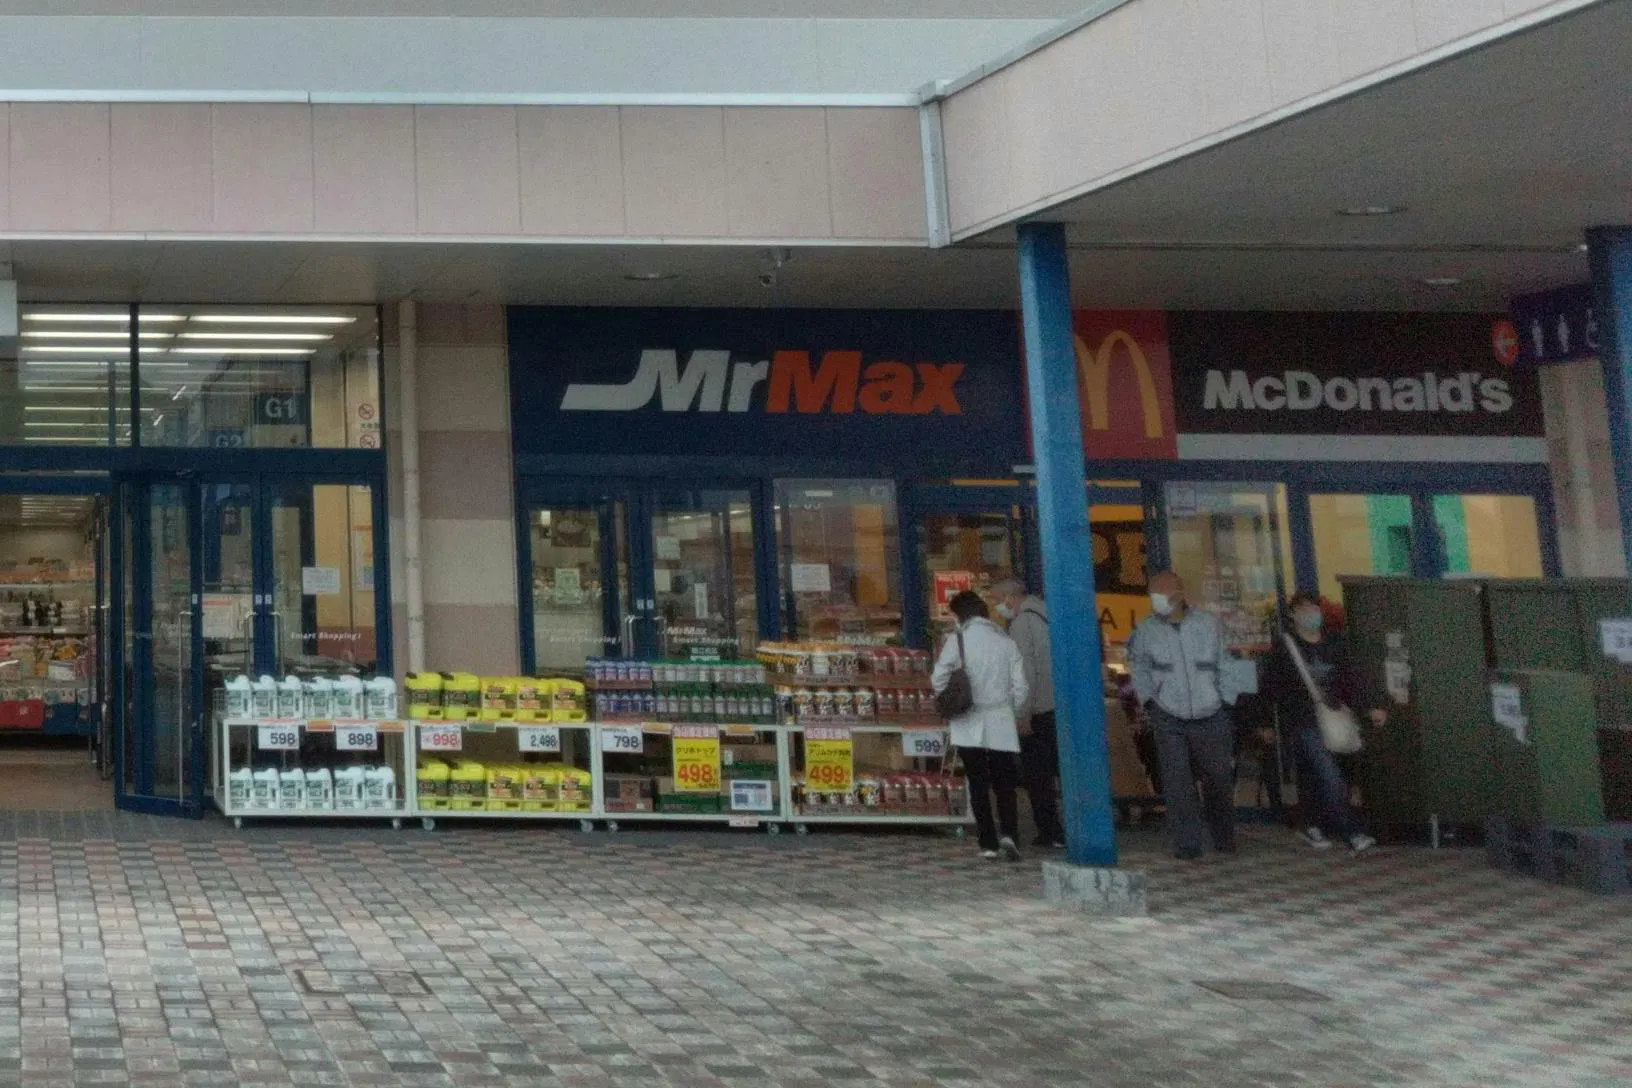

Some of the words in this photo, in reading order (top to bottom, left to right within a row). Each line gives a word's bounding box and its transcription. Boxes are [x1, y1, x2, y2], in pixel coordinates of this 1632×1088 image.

[558, 347, 966, 416] MrMax
[1202, 369, 1514, 413] McDonald's
[269, 731, 296, 746] 598
[347, 732, 374, 747] 898
[613, 735, 640, 749] 798
[677, 763, 714, 784] 498
[809, 764, 845, 785] 499
